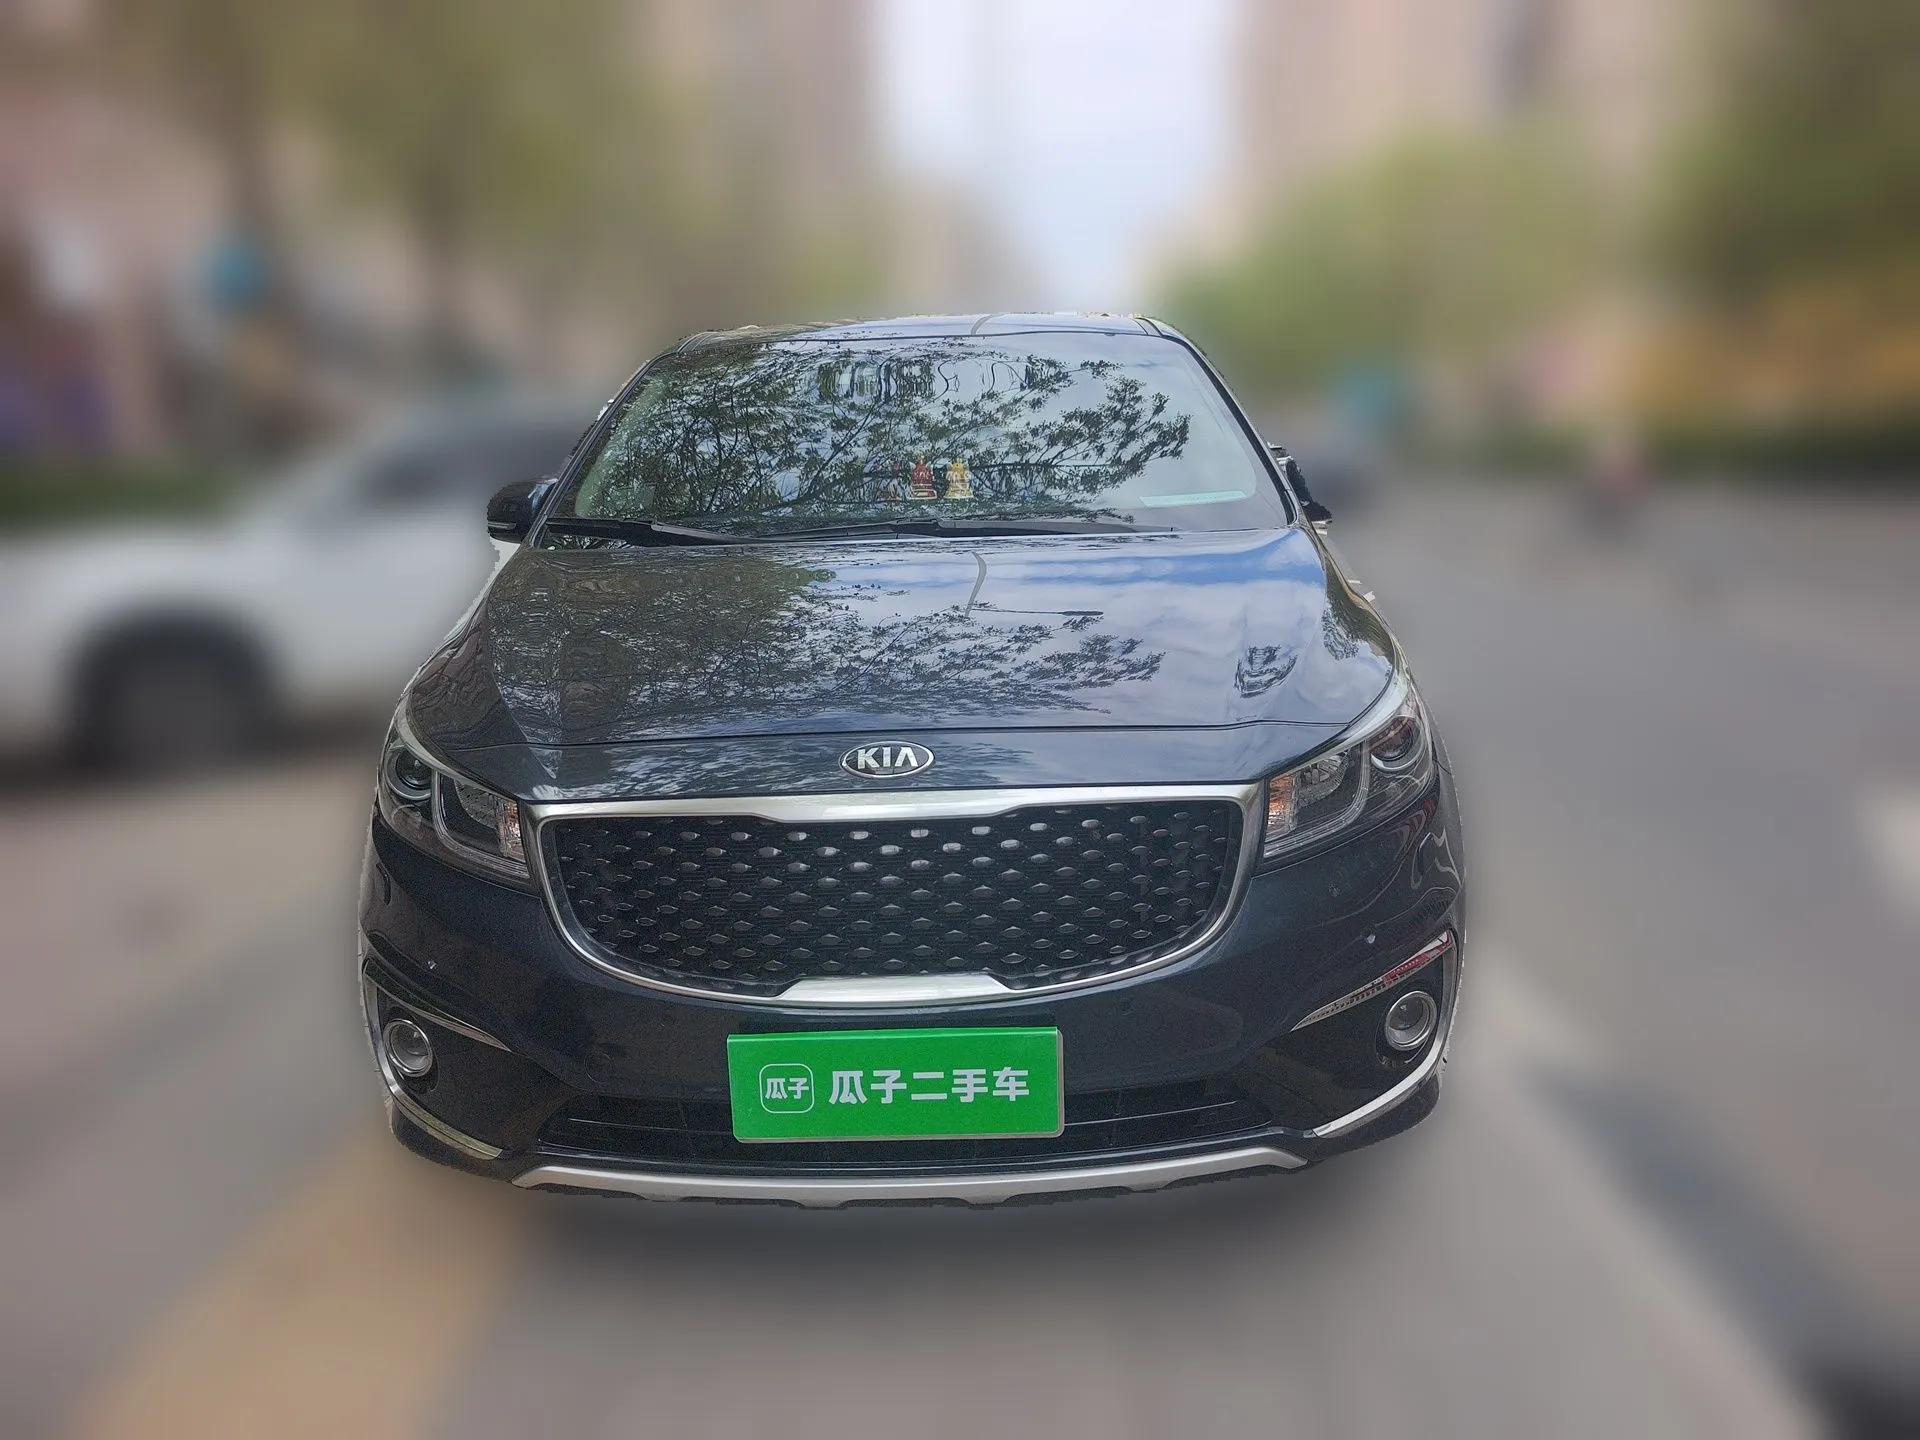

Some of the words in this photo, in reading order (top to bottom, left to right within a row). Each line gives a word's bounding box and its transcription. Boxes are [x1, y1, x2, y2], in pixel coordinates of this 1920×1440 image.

[857, 746, 919, 769] KIA
[765, 1077, 809, 1100] 瓜子
[828, 1066, 1030, 1105] 瓜子二手车
